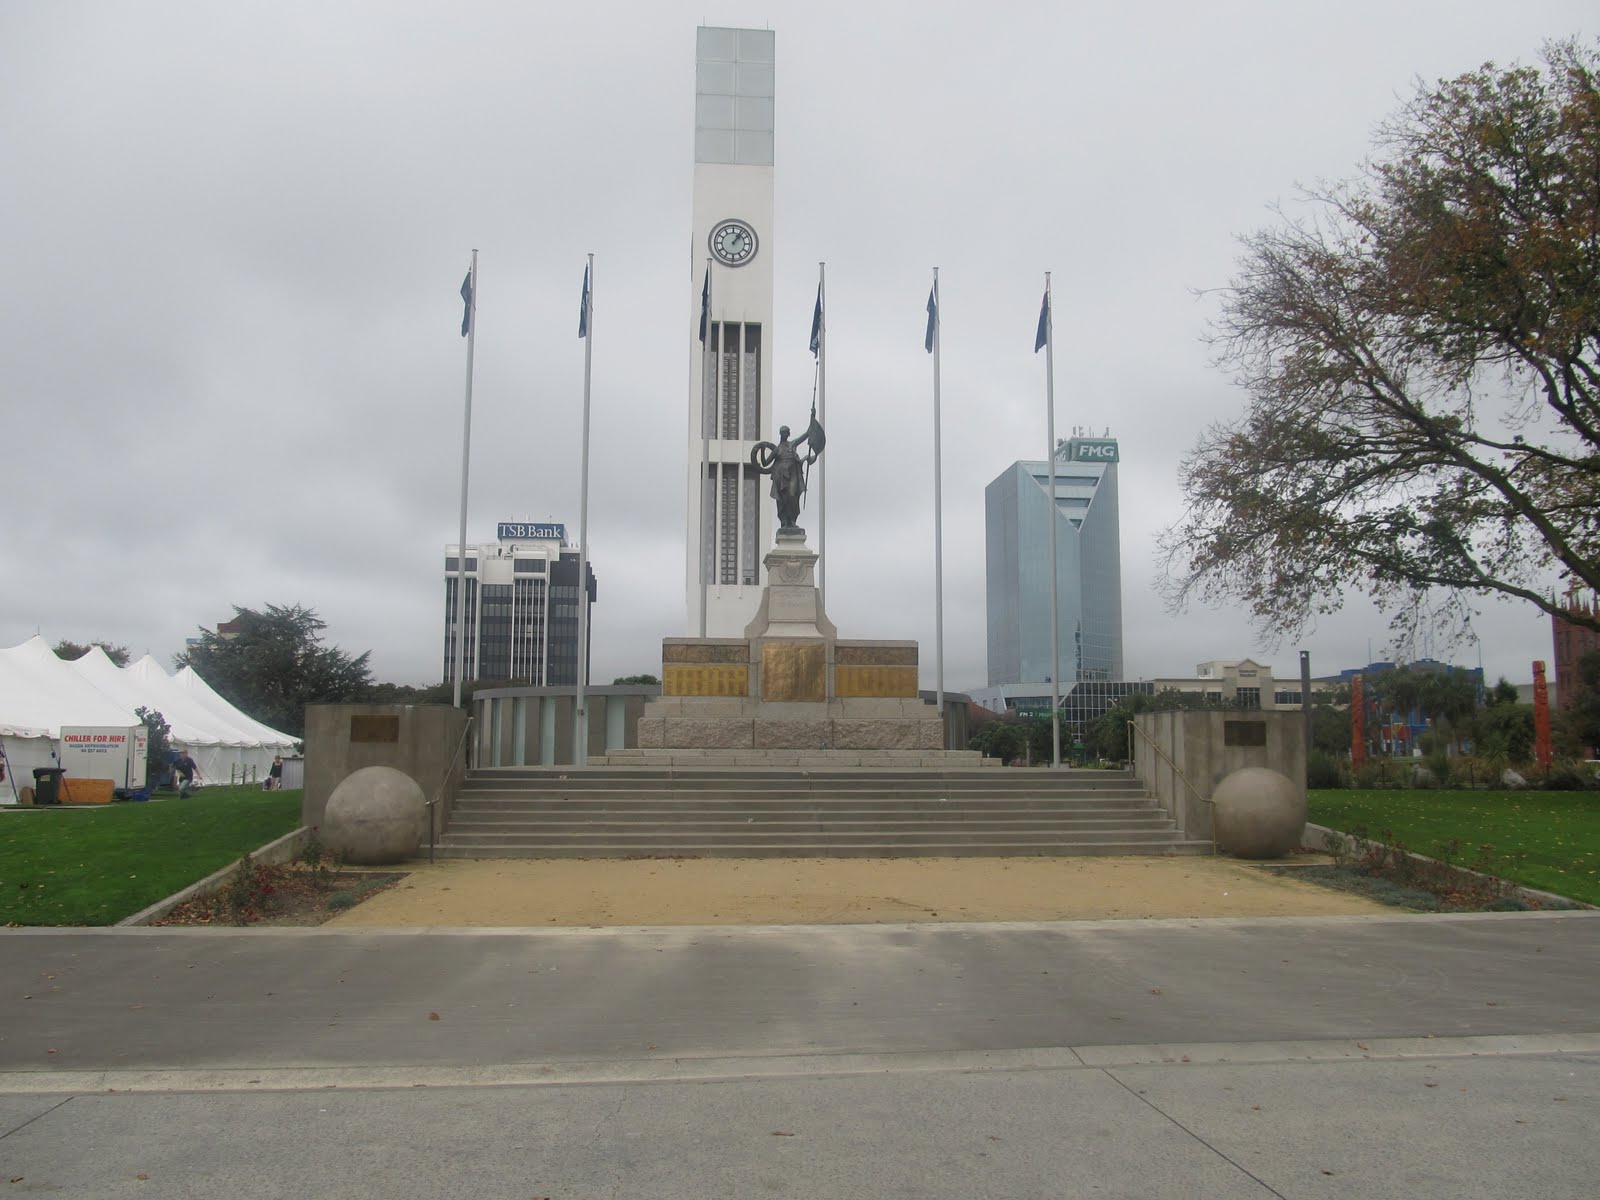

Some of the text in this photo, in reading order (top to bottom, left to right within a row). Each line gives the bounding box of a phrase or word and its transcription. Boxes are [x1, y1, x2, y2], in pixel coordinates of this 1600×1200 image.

[1079, 445, 1115, 457] FMG
[499, 524, 562, 538] TSB Bank
[64, 735, 127, 743] CHILLER FOR HIRE
